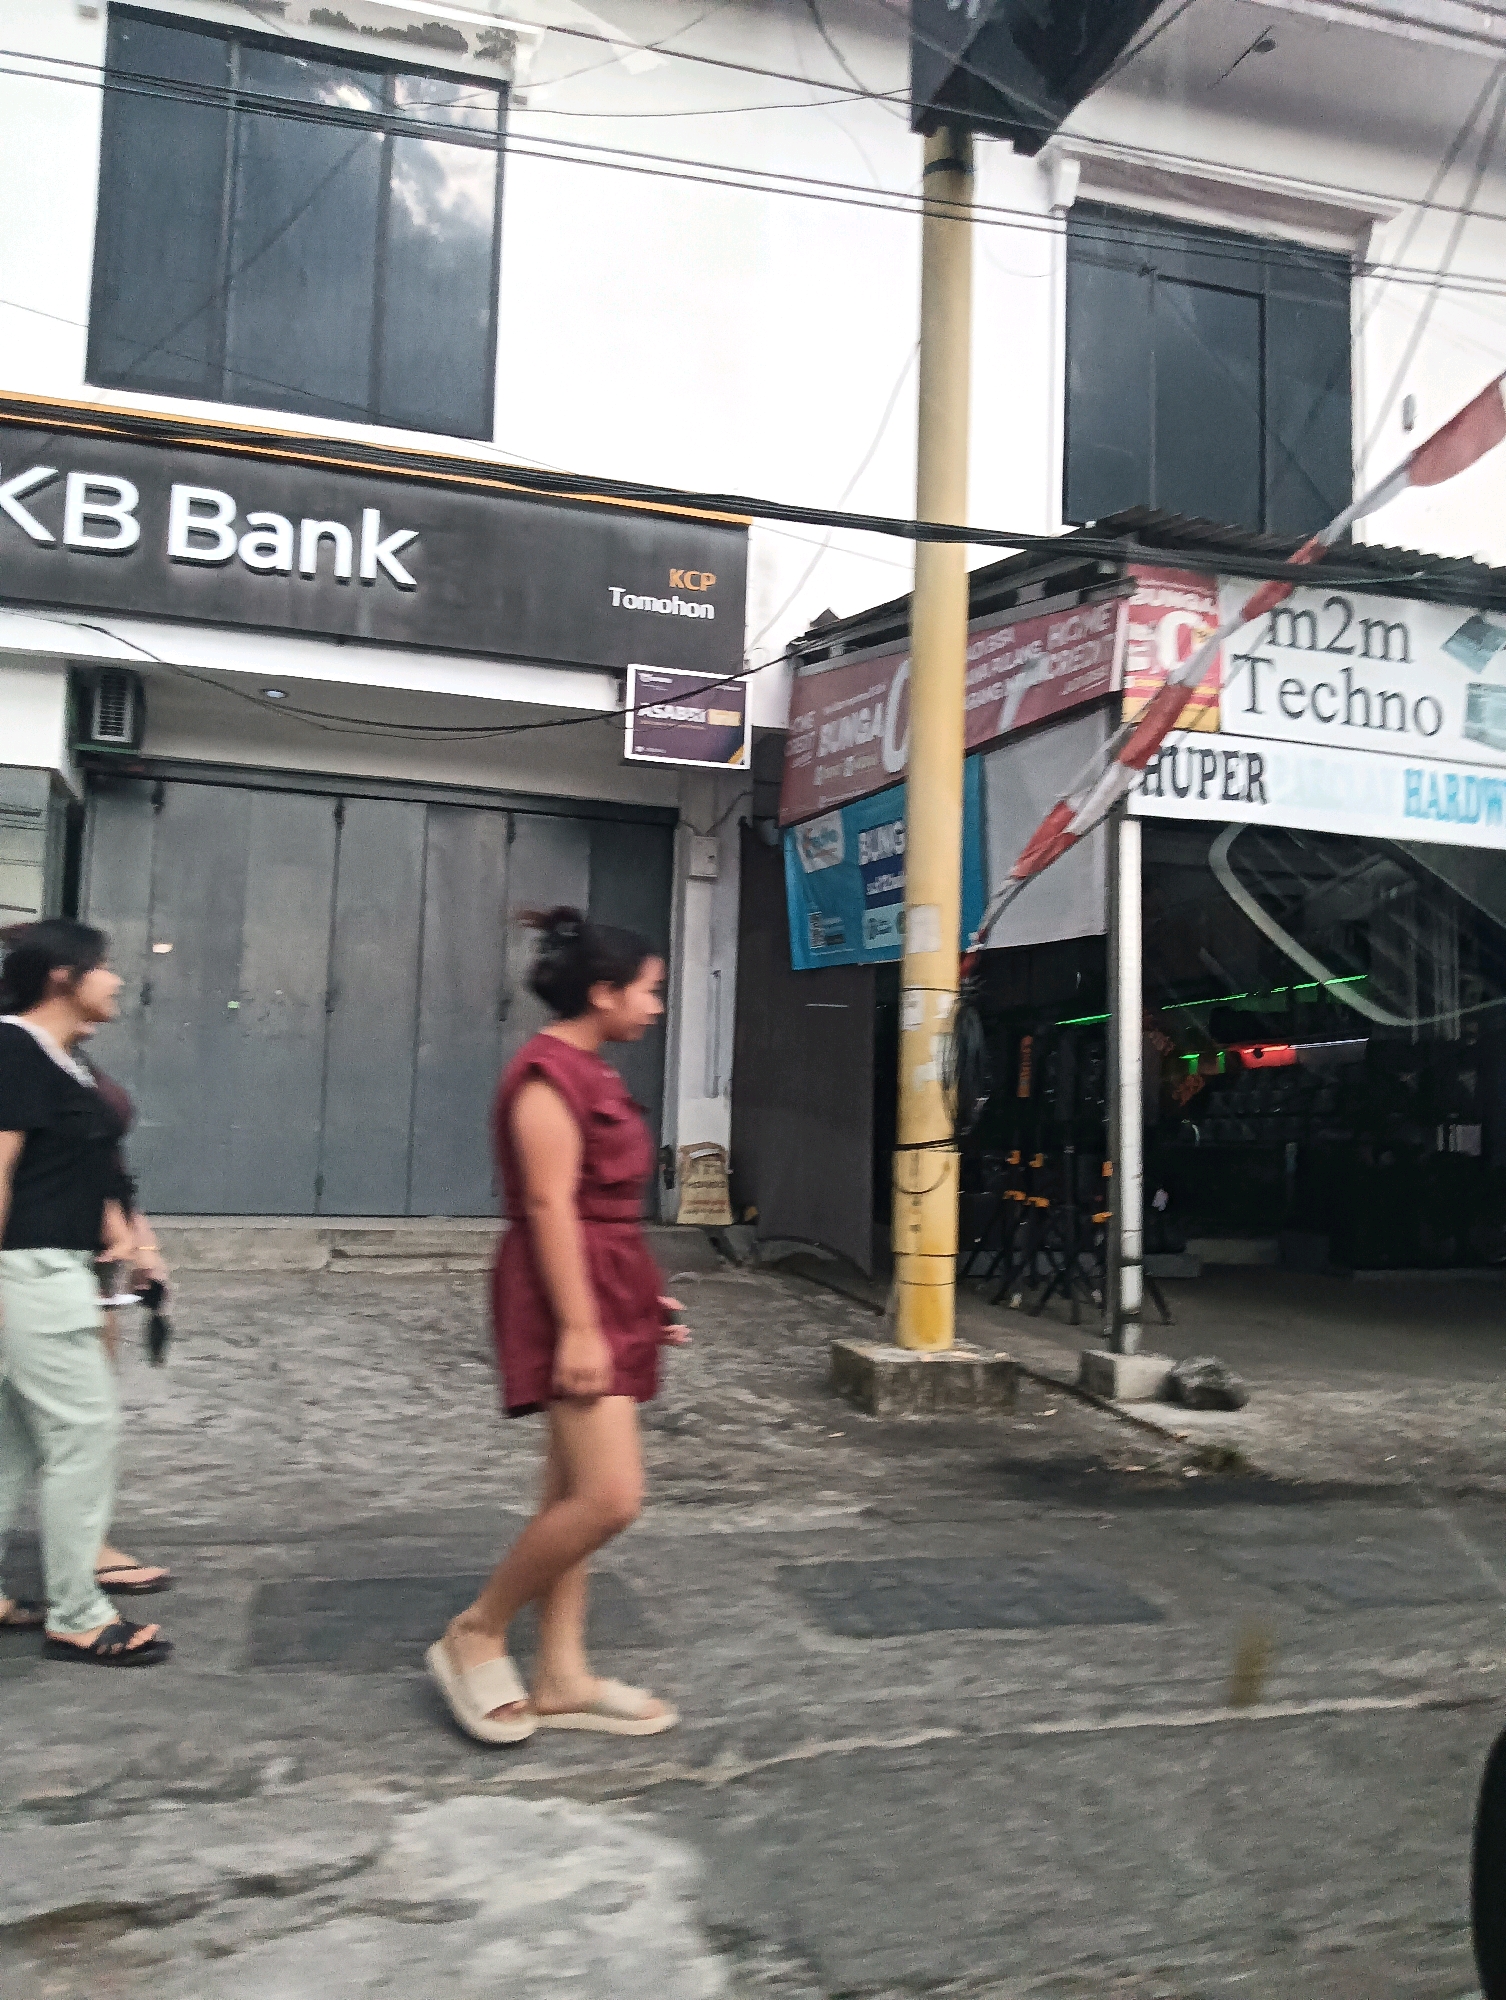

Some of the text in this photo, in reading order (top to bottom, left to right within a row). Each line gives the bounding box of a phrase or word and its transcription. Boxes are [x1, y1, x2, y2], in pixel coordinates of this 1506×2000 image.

[167, 484, 420, 587] Bank
[608, 586, 716, 620] Tomohon
[669, 568, 717, 591] KCP
[1269, 596, 1413, 664] m2m
[1232, 653, 1443, 738] Techno
